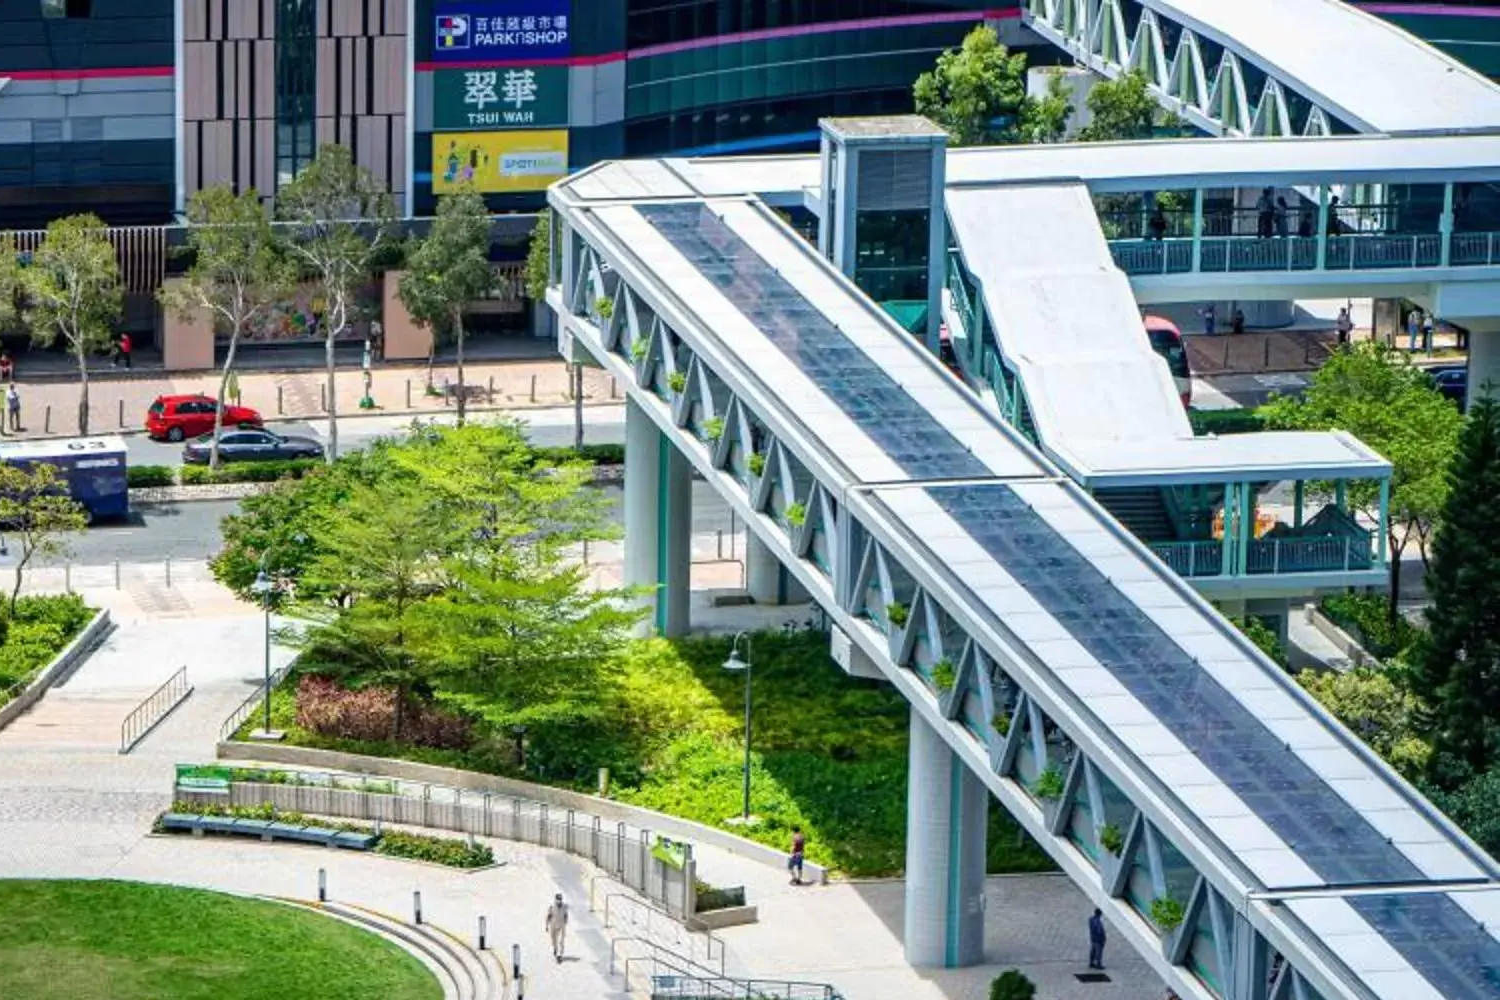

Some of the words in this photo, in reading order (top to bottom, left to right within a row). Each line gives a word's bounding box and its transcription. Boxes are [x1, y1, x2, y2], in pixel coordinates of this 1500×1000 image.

[463, 69, 537, 110] 翠華
[468, 112, 500, 125] TSUI
[502, 111, 533, 124] WAH
